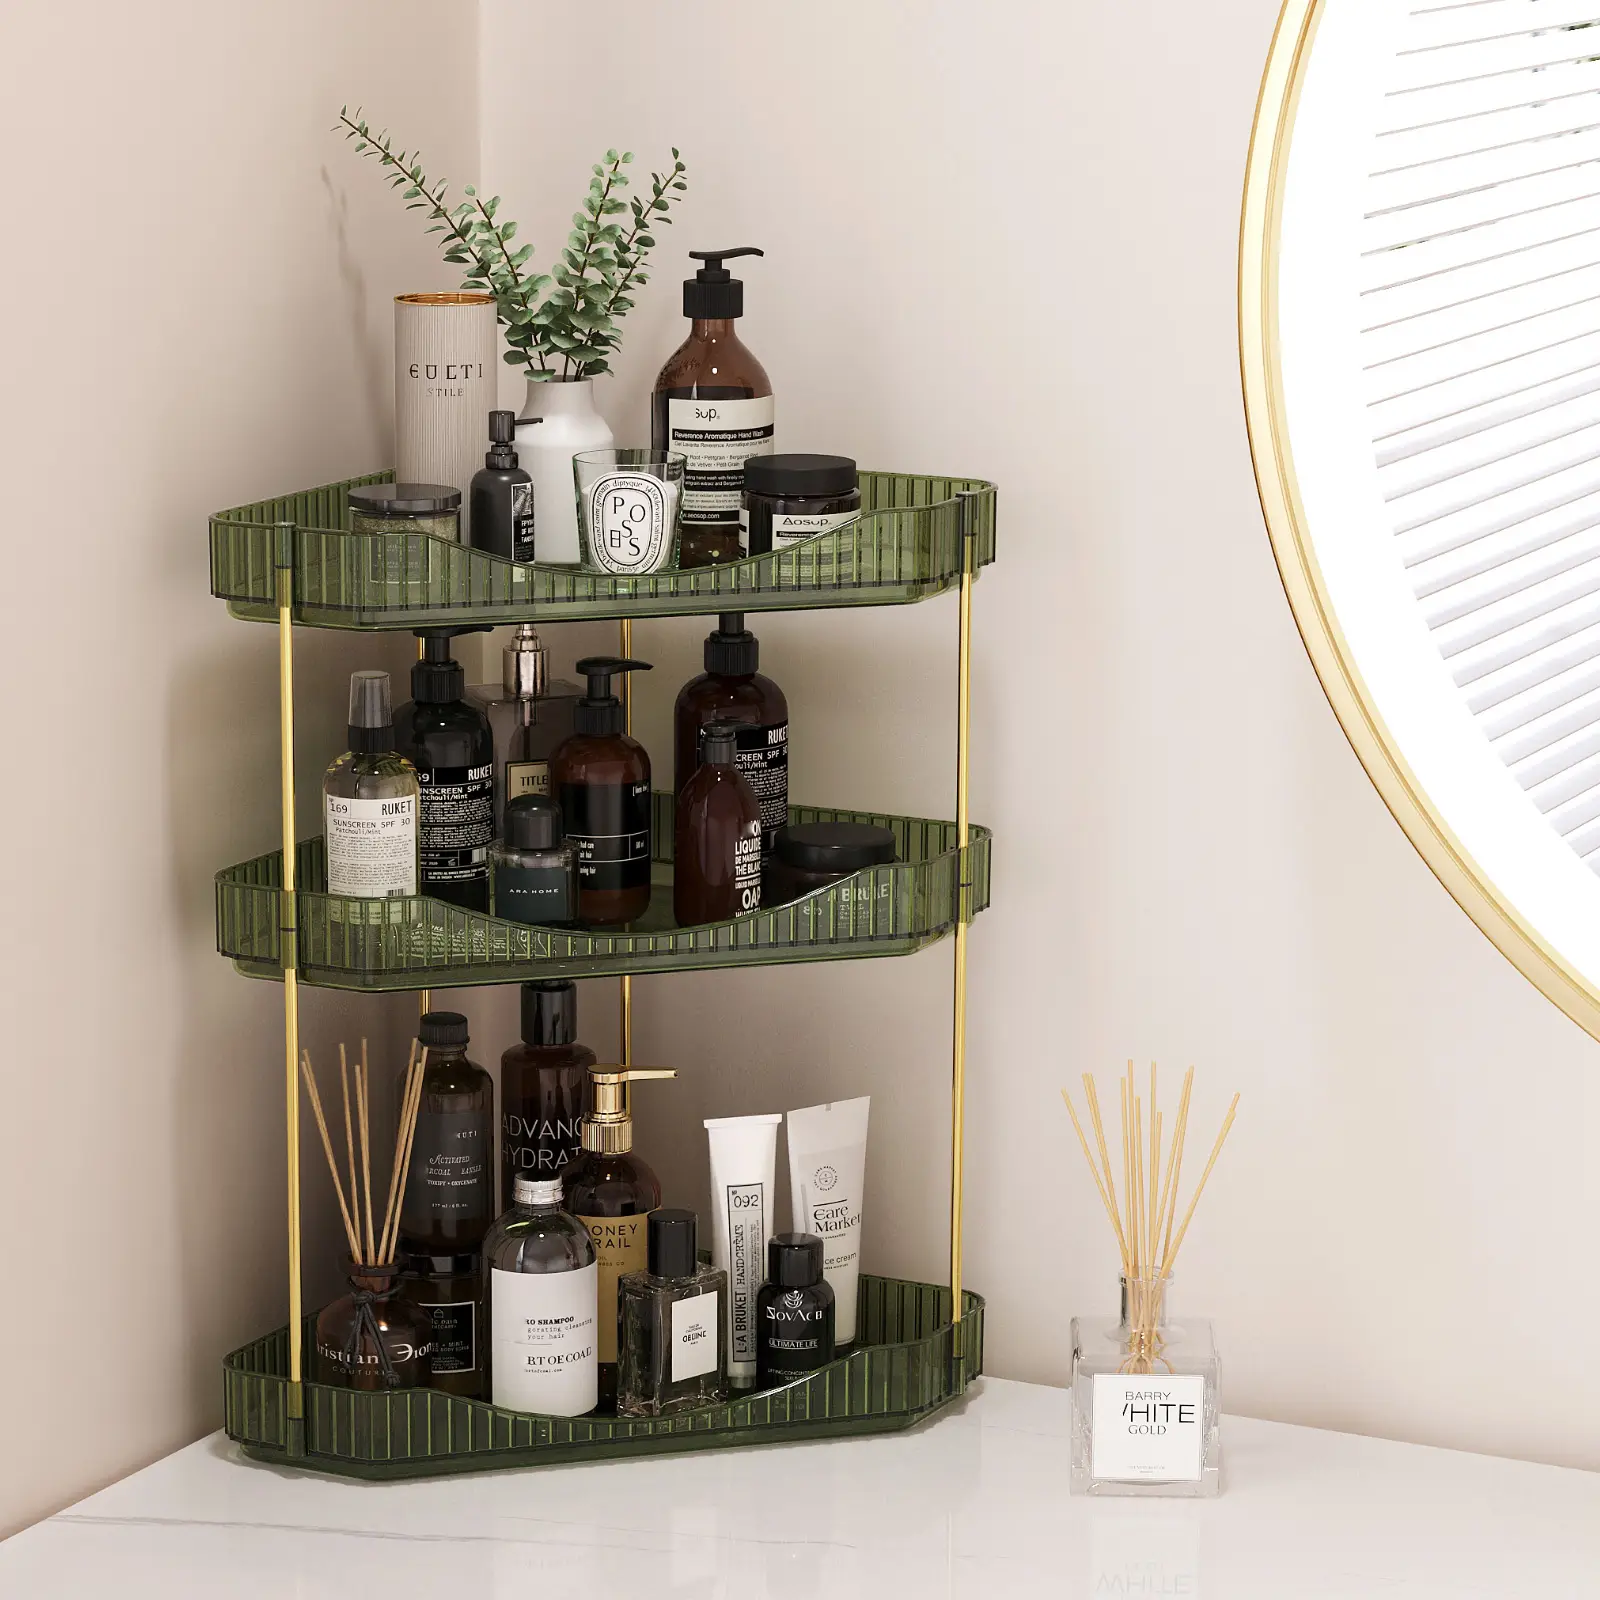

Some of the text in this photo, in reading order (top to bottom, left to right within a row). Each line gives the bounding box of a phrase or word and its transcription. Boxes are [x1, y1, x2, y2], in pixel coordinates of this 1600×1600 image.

[767, 749, 780, 760] SPF
[468, 764, 493, 782] RUKET
[520, 774, 549, 787] TITLE
[467, 784, 481, 793] SPF
[330, 802, 348, 814] 169
[381, 800, 412, 816] RUKET
[333, 818, 411, 829] SUNSCREEN SPF 30
[842, 883, 890, 902] BRUKE
[734, 1194, 758, 1208] 092
[814, 1213, 861, 1234] Market
[836, 1252, 857, 1264] cream
[734, 1290, 746, 1331] BRUKET
[538, 1316, 574, 1326] SHAMPOO
[332, 1366, 385, 1376] COUTUR
[1125, 1391, 1172, 1400] BARRY
[1128, 1424, 1167, 1435] GOLD
